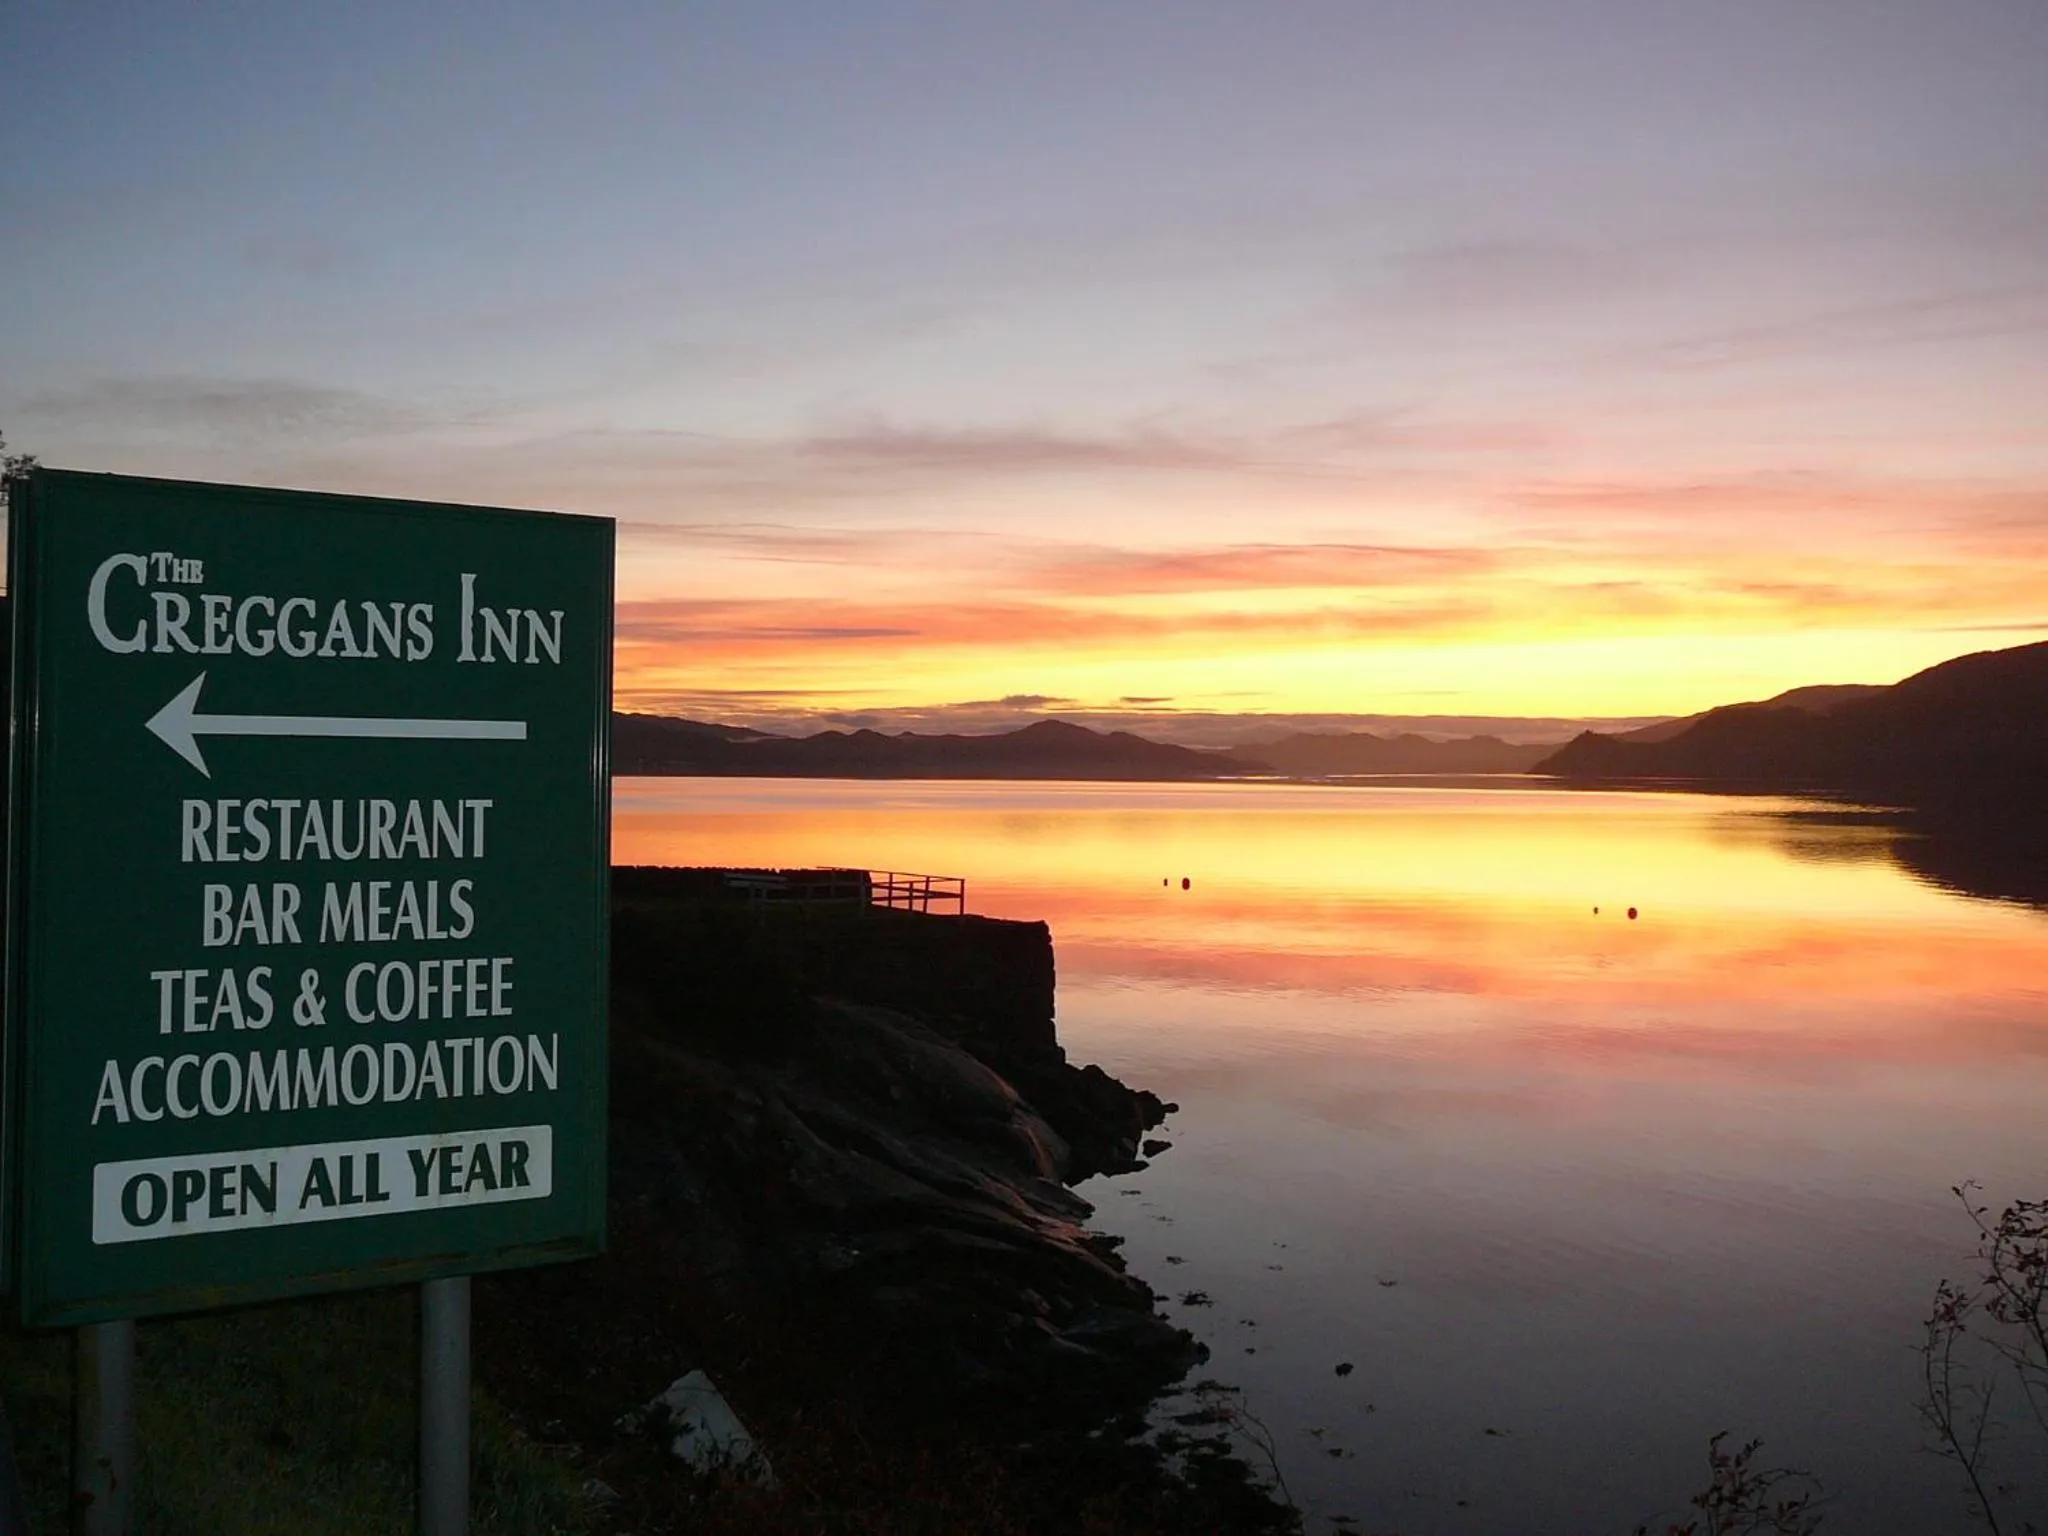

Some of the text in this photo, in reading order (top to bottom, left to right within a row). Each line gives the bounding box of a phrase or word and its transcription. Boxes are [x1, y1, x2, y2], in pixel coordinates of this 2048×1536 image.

[150, 551, 204, 584] THE
[87, 552, 565, 664] CREGGANS INN
[181, 798, 494, 863] RESTAURANT
[202, 878, 475, 947] BAR MEALS
[150, 957, 514, 1034] TEAS & COFFEE
[90, 1033, 559, 1125] ACCOMMODATION
[120, 1140, 531, 1227] OPEN ALL YEAR
